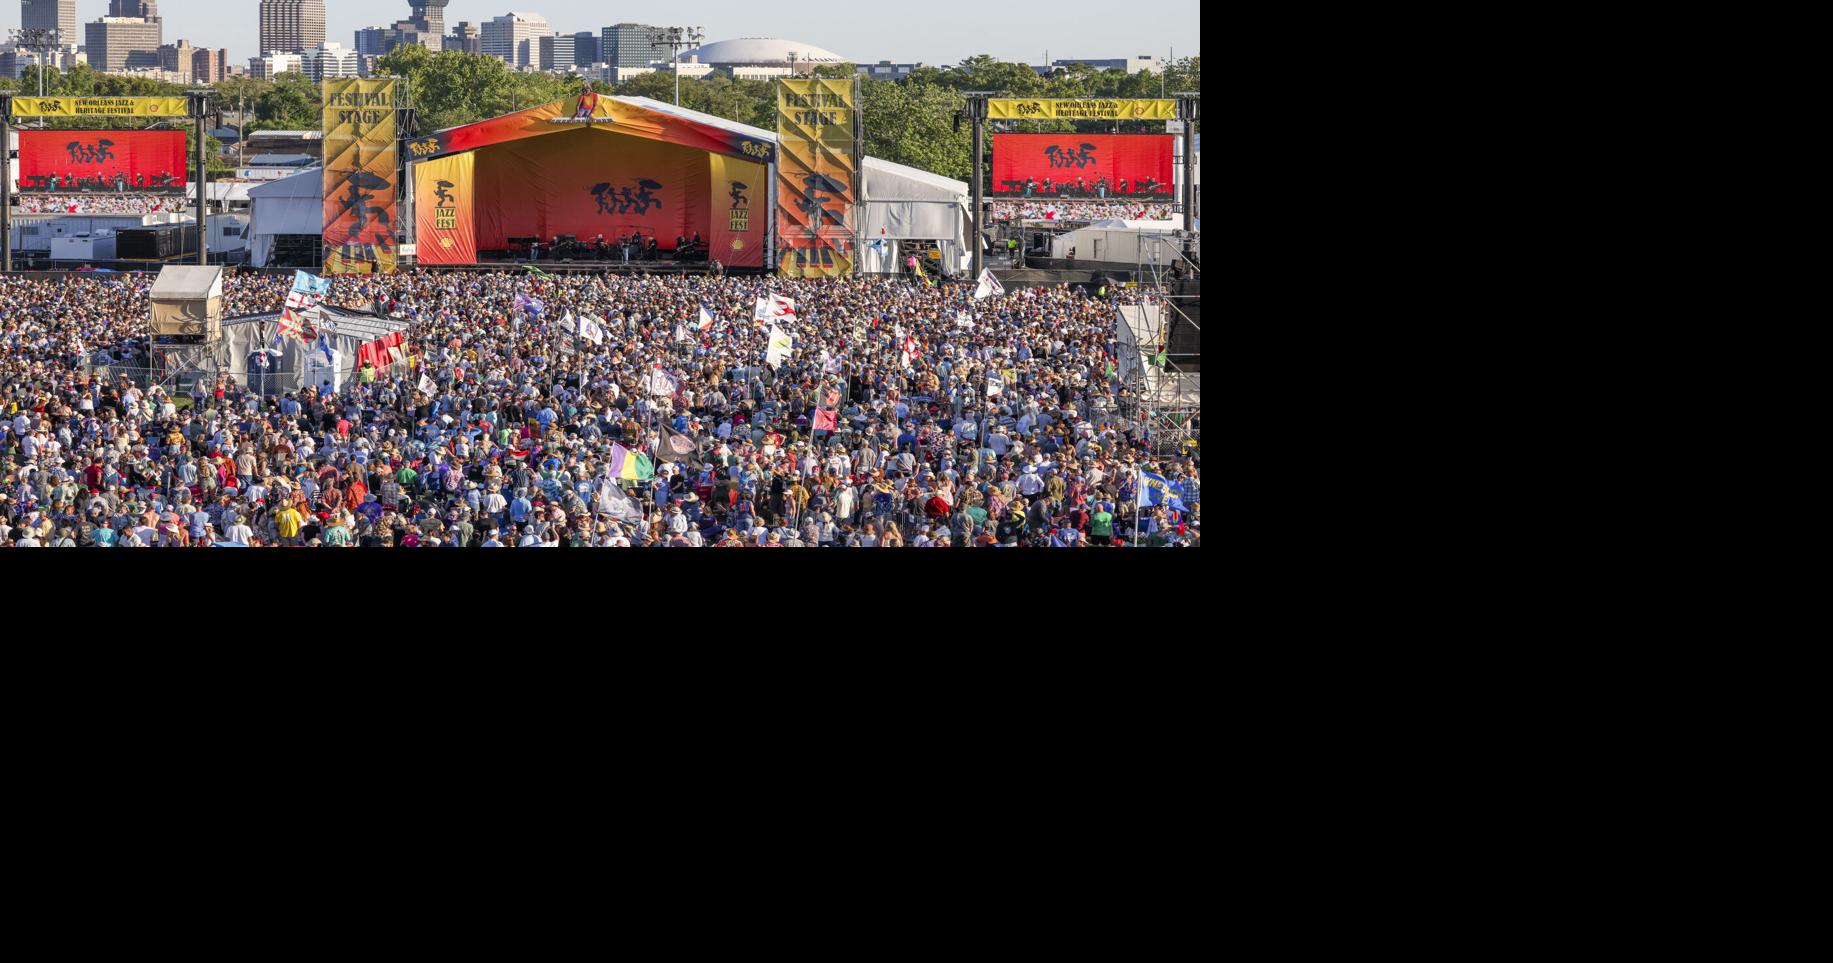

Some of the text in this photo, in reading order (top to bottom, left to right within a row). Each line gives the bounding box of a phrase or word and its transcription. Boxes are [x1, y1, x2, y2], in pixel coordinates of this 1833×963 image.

[330, 93, 389, 106] FESTIVAL
[786, 94, 845, 107] FESTIVAL
[339, 110, 380, 124] STAGE
[1055, 109, 1119, 117] HERITAGE FESTIVAL
[794, 111, 837, 126] STAGE
[436, 208, 455, 218] JAZZ
[731, 210, 748, 219] JAZZ
[436, 219, 455, 228] FEST
[730, 220, 748, 229] FEST
